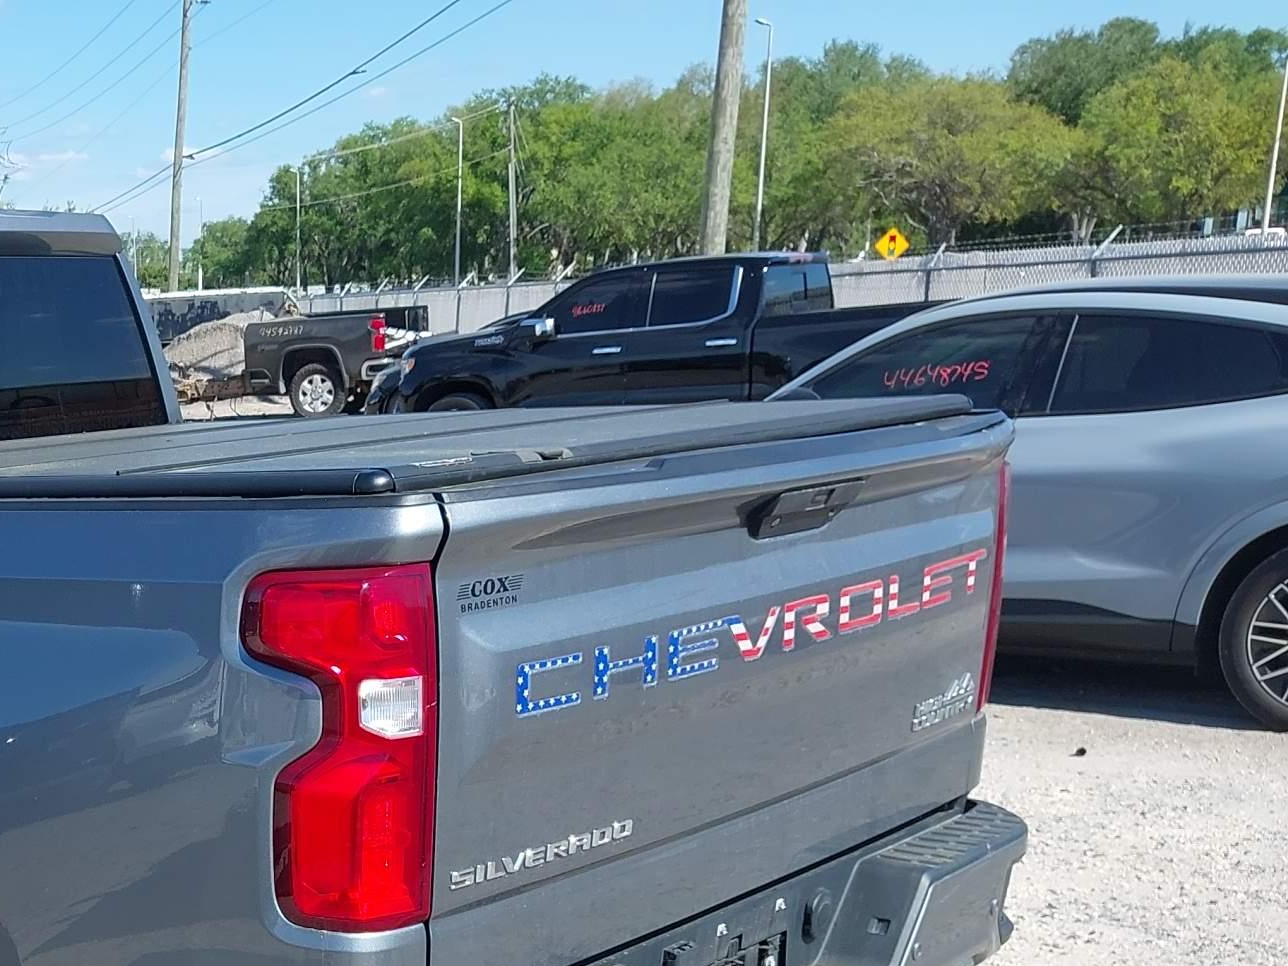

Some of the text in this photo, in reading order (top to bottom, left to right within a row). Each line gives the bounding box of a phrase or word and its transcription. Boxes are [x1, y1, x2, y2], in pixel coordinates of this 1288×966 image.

[884, 361, 991, 388] 44648745
[470, 576, 510, 598] COX
[460, 594, 518, 613] BRADENTON
[516, 548, 987, 718] CHEVROLET
[449, 819, 633, 890] SILVERADO
